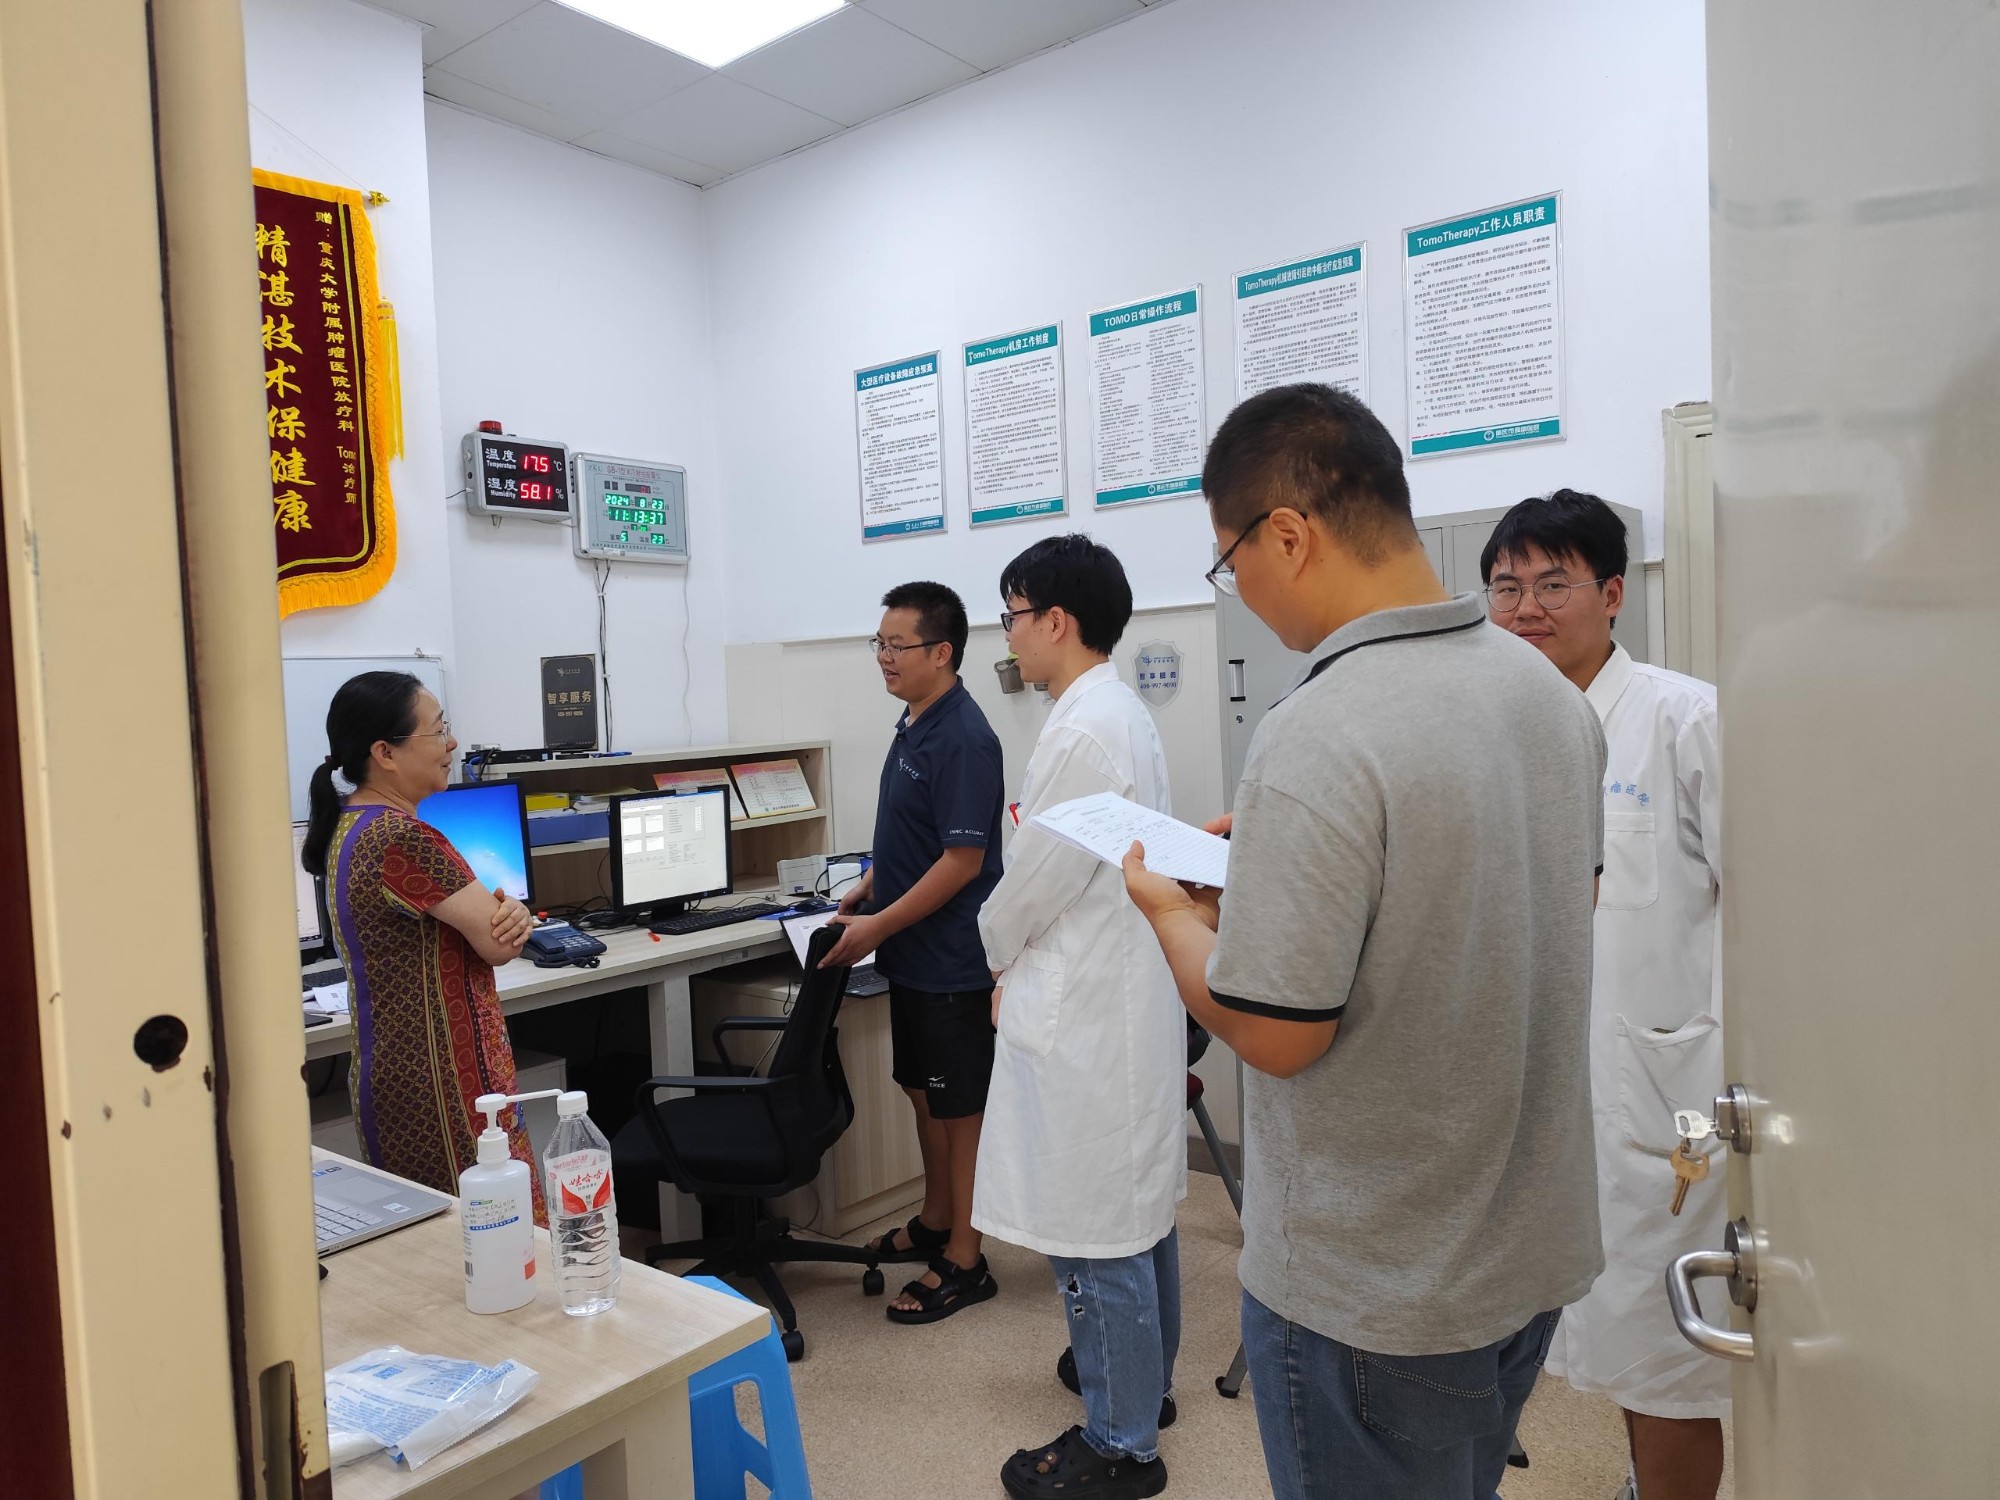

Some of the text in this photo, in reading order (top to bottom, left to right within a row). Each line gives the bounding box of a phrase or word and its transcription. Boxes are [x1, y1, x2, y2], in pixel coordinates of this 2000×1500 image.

[1417, 206, 1545, 248] TomoTherapy工作人员职责
[1104, 299, 1183, 327] TOMO日常操作流程
[968, 331, 1049, 363] TomoTherapy机房工作制度
[256, 222, 316, 533] 精湛技术保健康
[485, 447, 517, 463] 温度
[486, 460, 517, 471] Temperature
[487, 477, 518, 491] 湿度
[520, 483, 552, 500] 58.1
[490, 489, 516, 500] Humidity
[605, 494, 629, 506] 2024
[652, 499, 663, 508] 23
[651, 535, 663, 544] 23
[547, 691, 592, 705] 智享服务
